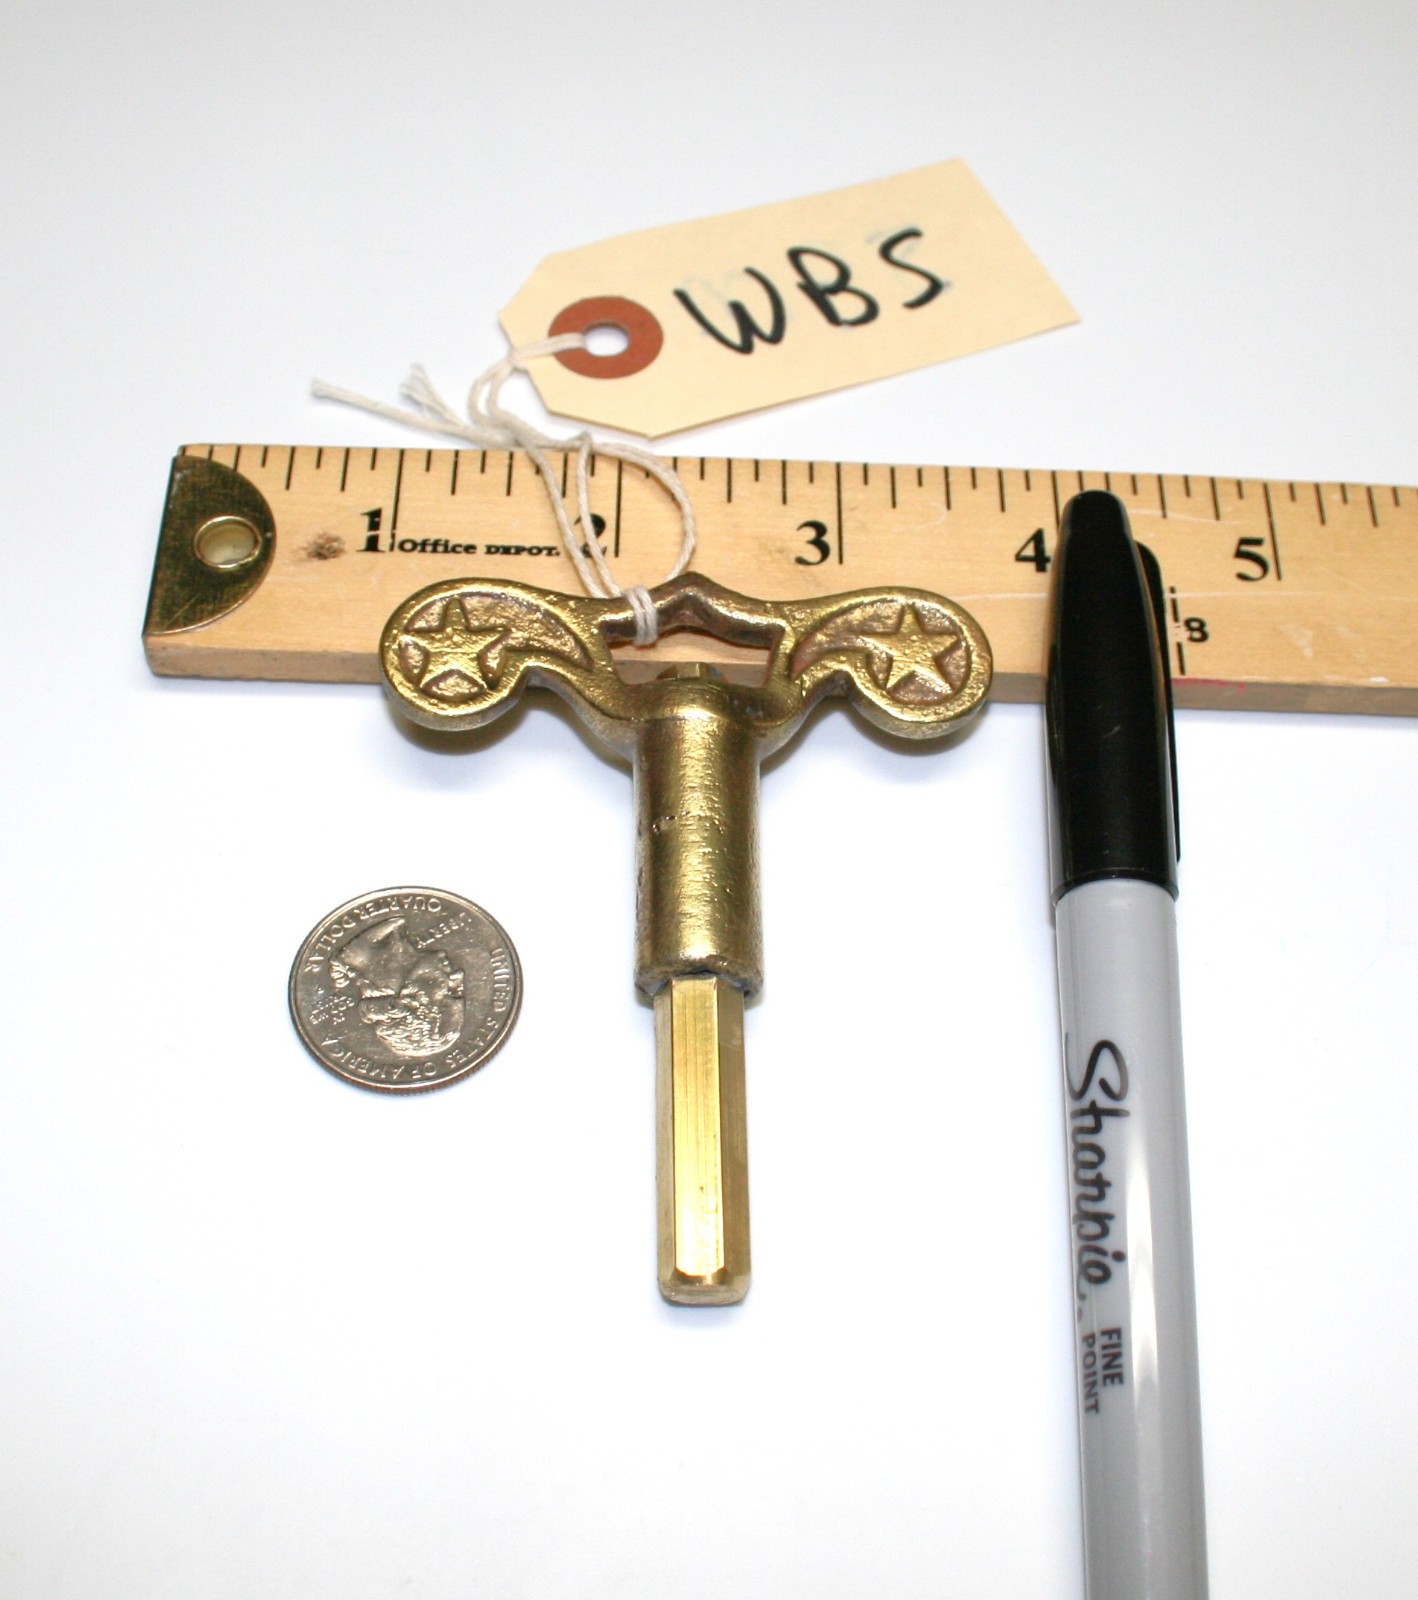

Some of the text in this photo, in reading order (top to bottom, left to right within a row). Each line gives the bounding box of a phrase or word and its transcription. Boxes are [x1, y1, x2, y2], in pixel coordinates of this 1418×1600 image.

[673, 228, 945, 354] WBS
[357, 507, 386, 553] 1
[397, 538, 478, 555] Office
[794, 519, 831, 566] 3
[1014, 527, 1051, 573] 4
[1233, 536, 1270, 582] 5
[1183, 616, 1209, 643] 8
[303, 896, 442, 973] QUARTER DOLLAR
[416, 912, 472, 949] LIBERTY
[321, 948, 512, 1080] UNITED STATES OF AMERICA
[1082, 1331, 1099, 1414] POINT
[1100, 1327, 1124, 1386] FINE
